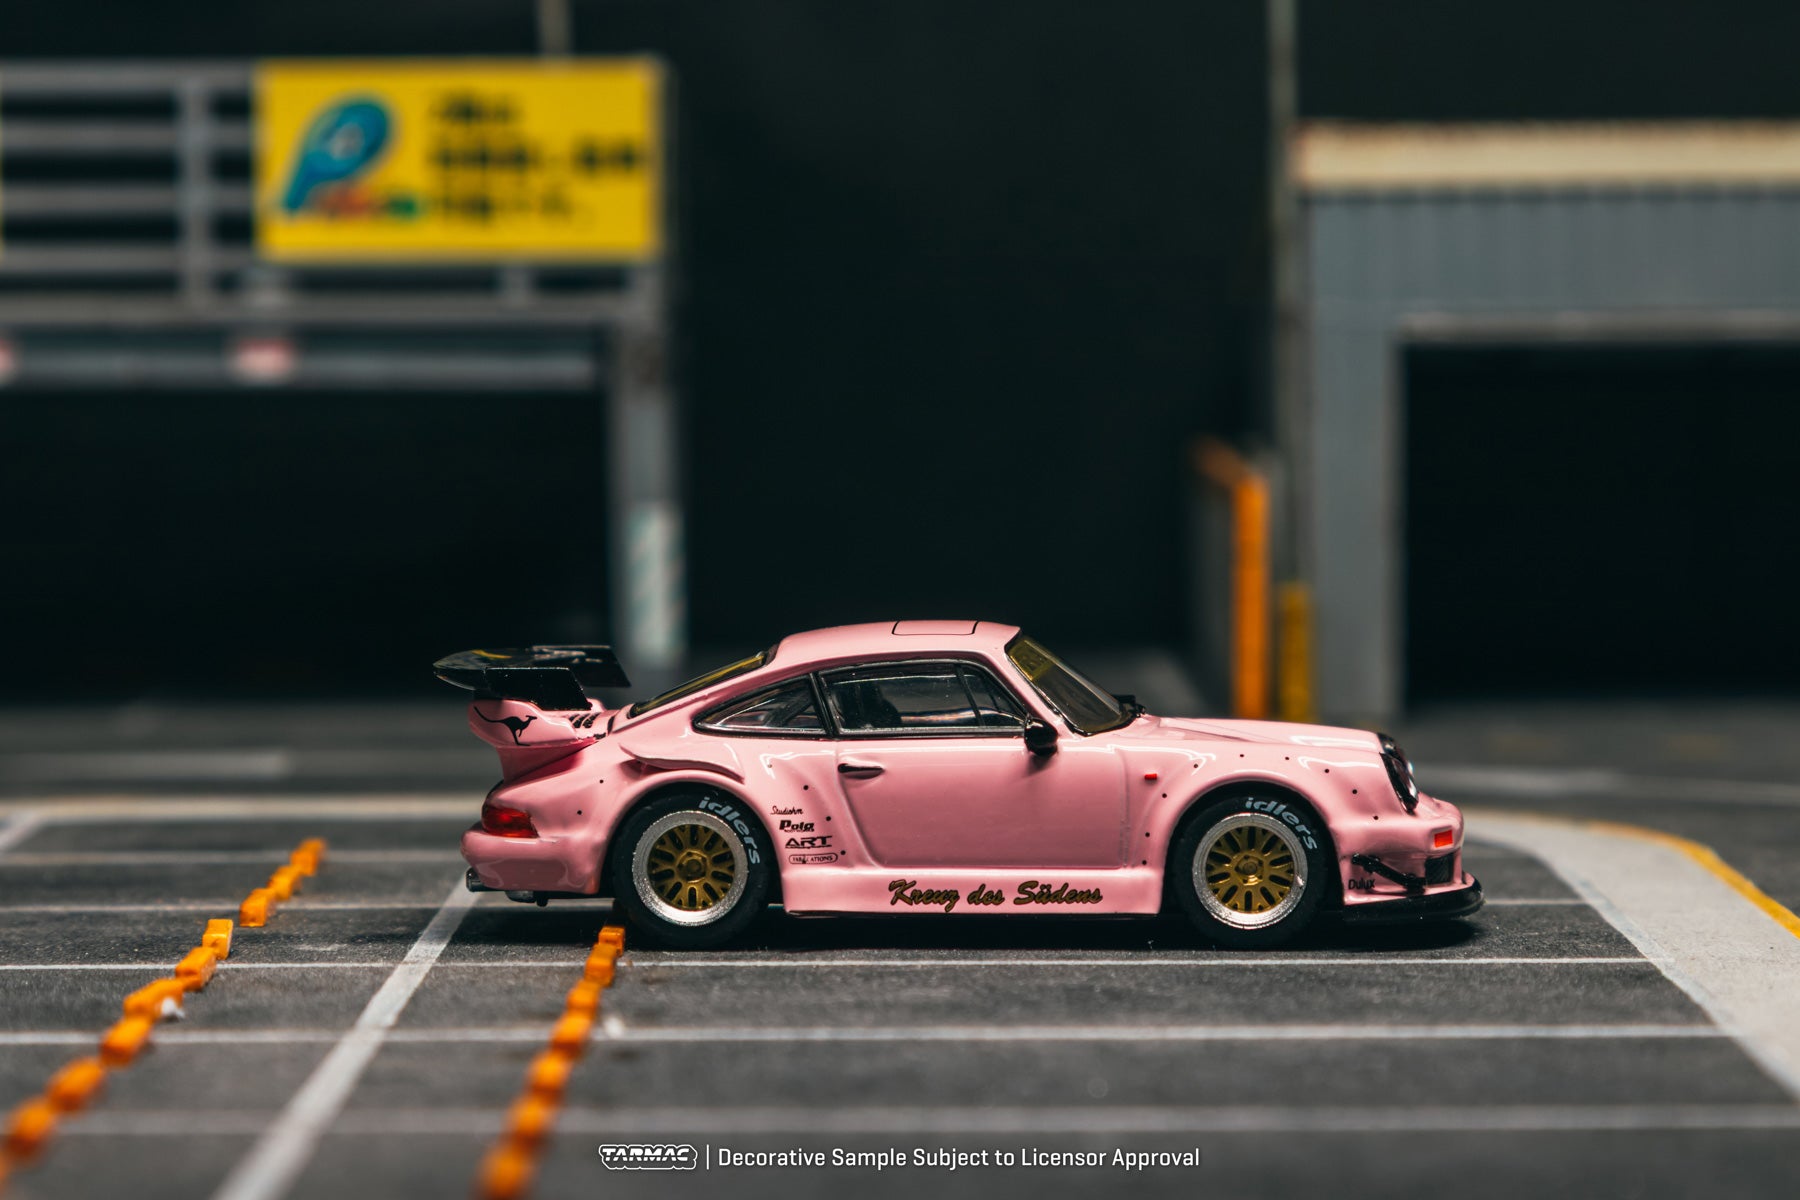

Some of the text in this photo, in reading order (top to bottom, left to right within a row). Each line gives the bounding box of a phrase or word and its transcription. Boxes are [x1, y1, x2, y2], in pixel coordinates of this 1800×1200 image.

[698, 796, 761, 865] idlers
[785, 836, 832, 849] ART
[1245, 797, 1318, 850] idlers
[967, 883, 1005, 906] des
